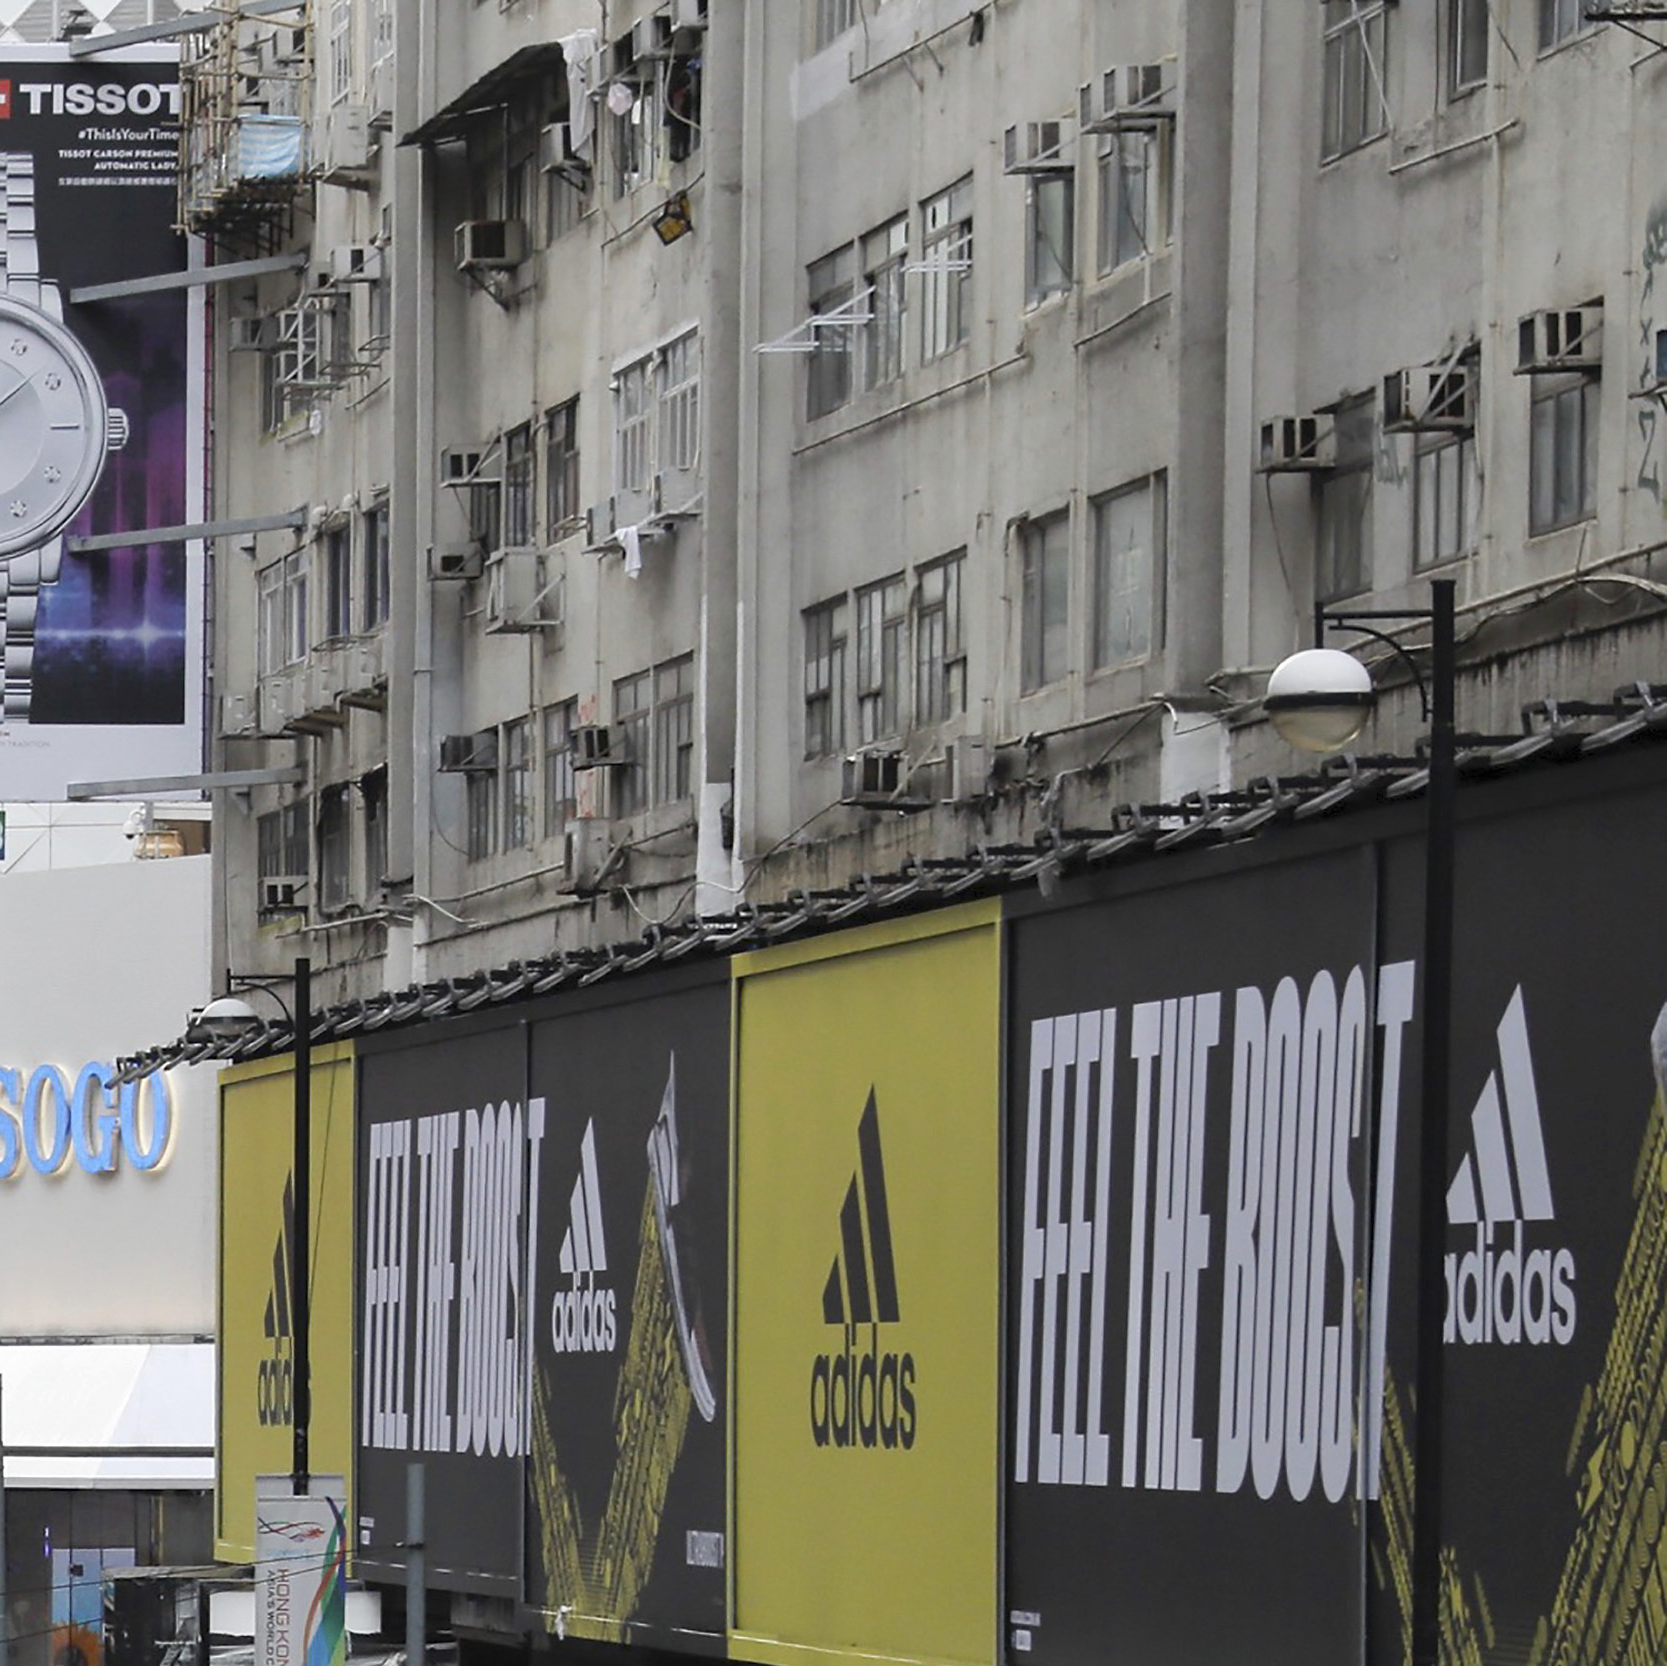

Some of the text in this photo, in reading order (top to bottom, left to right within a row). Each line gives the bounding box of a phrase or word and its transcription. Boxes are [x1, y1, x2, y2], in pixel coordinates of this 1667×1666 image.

[19, 83, 182, 115] TISSOT
[78, 128, 179, 141] #ThisIsYourTime
[59, 150, 91, 158] TISSOT
[94, 161, 149, 171] AUTOMATIC
[1015, 959, 1418, 1505] FEEL THE BOOST
[362, 1096, 546, 1459] FEEL THE BOOST
[551, 1269, 618, 1355] adidas
[1441, 1219, 1579, 1347] adidas
[809, 1319, 917, 1452] adidas
[276, 1568, 290, 1626] HONG
